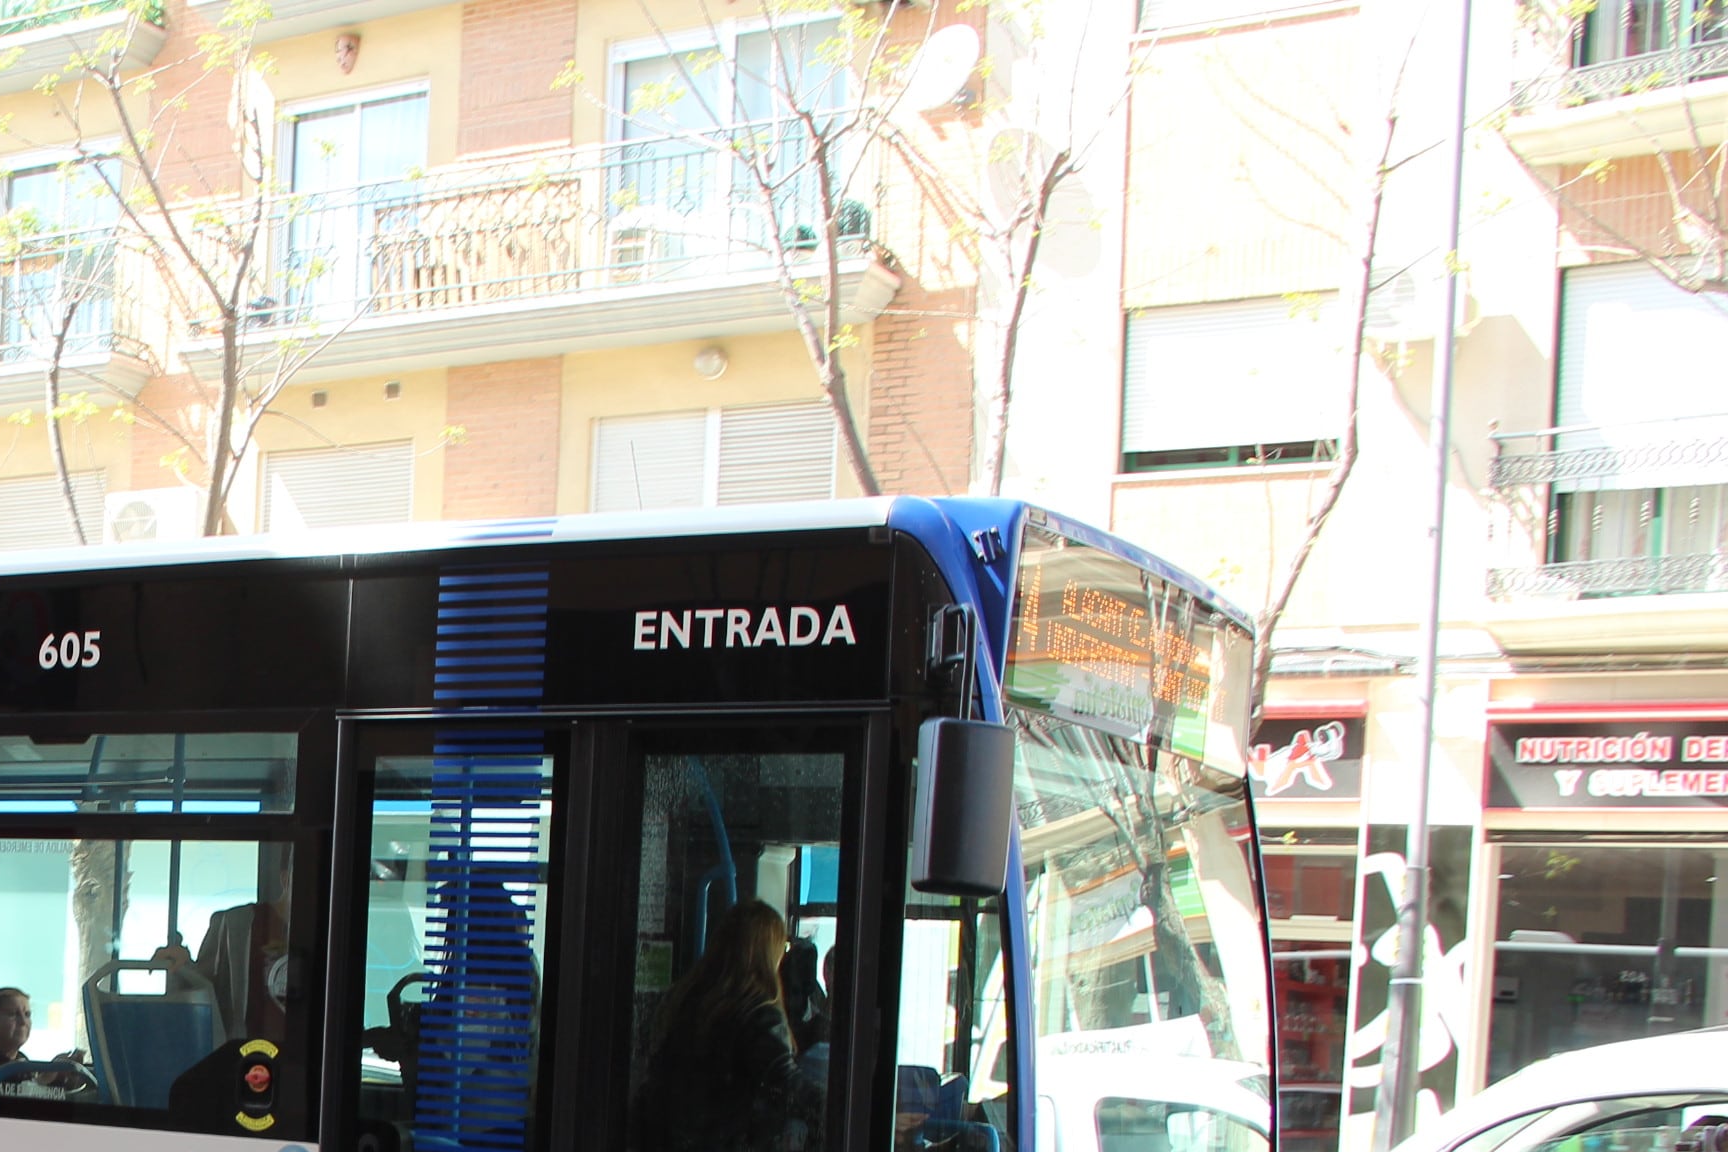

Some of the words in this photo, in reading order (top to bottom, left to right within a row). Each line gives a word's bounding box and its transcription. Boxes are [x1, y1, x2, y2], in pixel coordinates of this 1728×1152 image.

[634, 604, 856, 650] ENTRADA
[39, 631, 101, 670] 605
[1516, 732, 1674, 763] NUTRICIÓN
[1554, 769, 1583, 797] Y
[5, 1083, 15, 1097] DE
